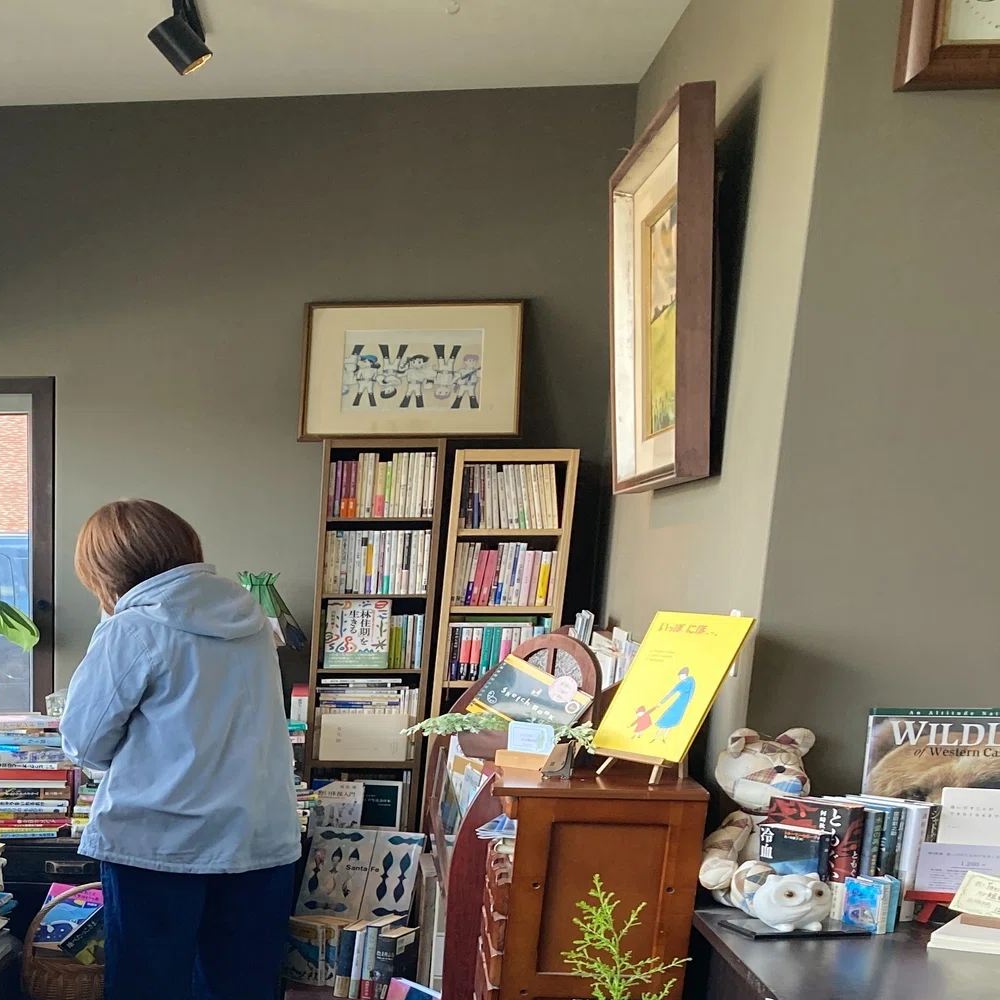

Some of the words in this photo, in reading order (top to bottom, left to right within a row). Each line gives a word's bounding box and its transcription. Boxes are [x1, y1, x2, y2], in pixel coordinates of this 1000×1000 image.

[500, 686, 531, 707] Sketch
[531, 704, 556, 721] Book
[913, 747, 926, 758] of
[929, 747, 980, 757] Western
[760, 828, 775, 859] 冷血
[345, 864, 368, 873] Santa
